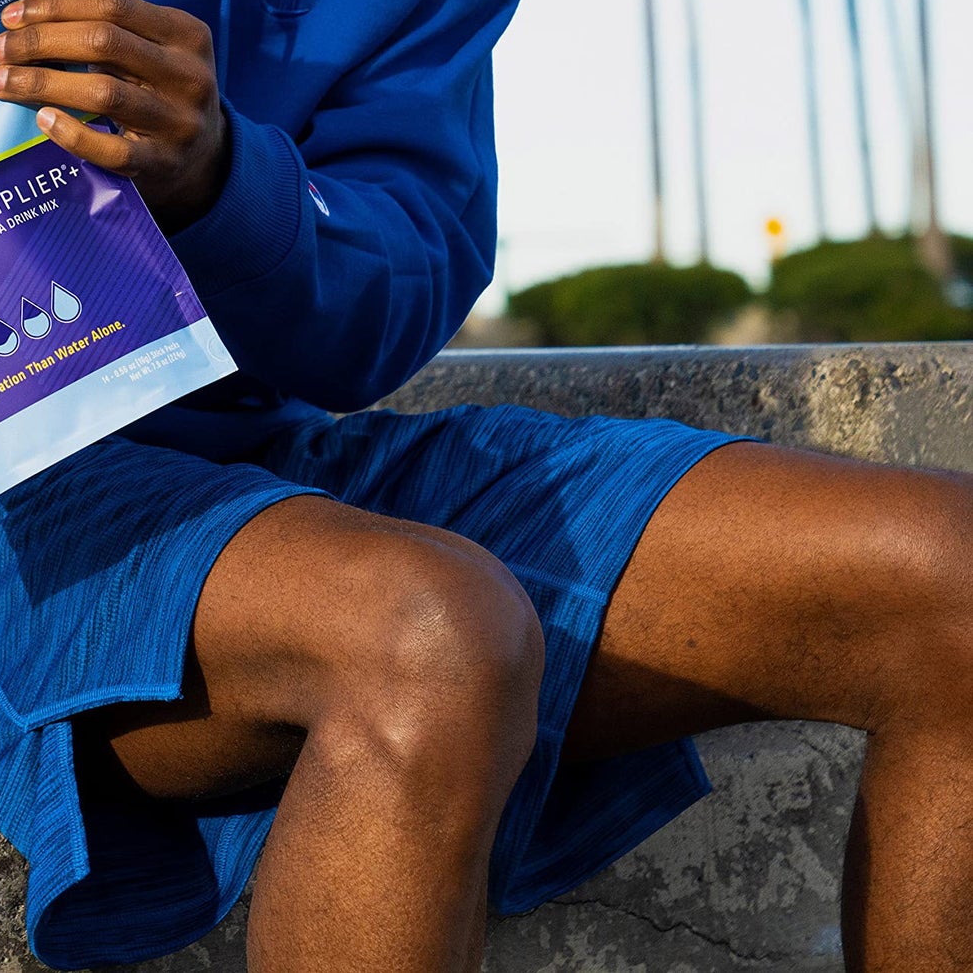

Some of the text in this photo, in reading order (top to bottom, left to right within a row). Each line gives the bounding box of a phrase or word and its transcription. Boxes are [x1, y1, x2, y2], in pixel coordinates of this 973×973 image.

[6, 208, 39, 229] DRINK
[39, 198, 59, 214] MIX
[25, 355, 55, 376] Than
[54, 336, 90, 362] Water
[90, 320, 126, 343] Alone.
